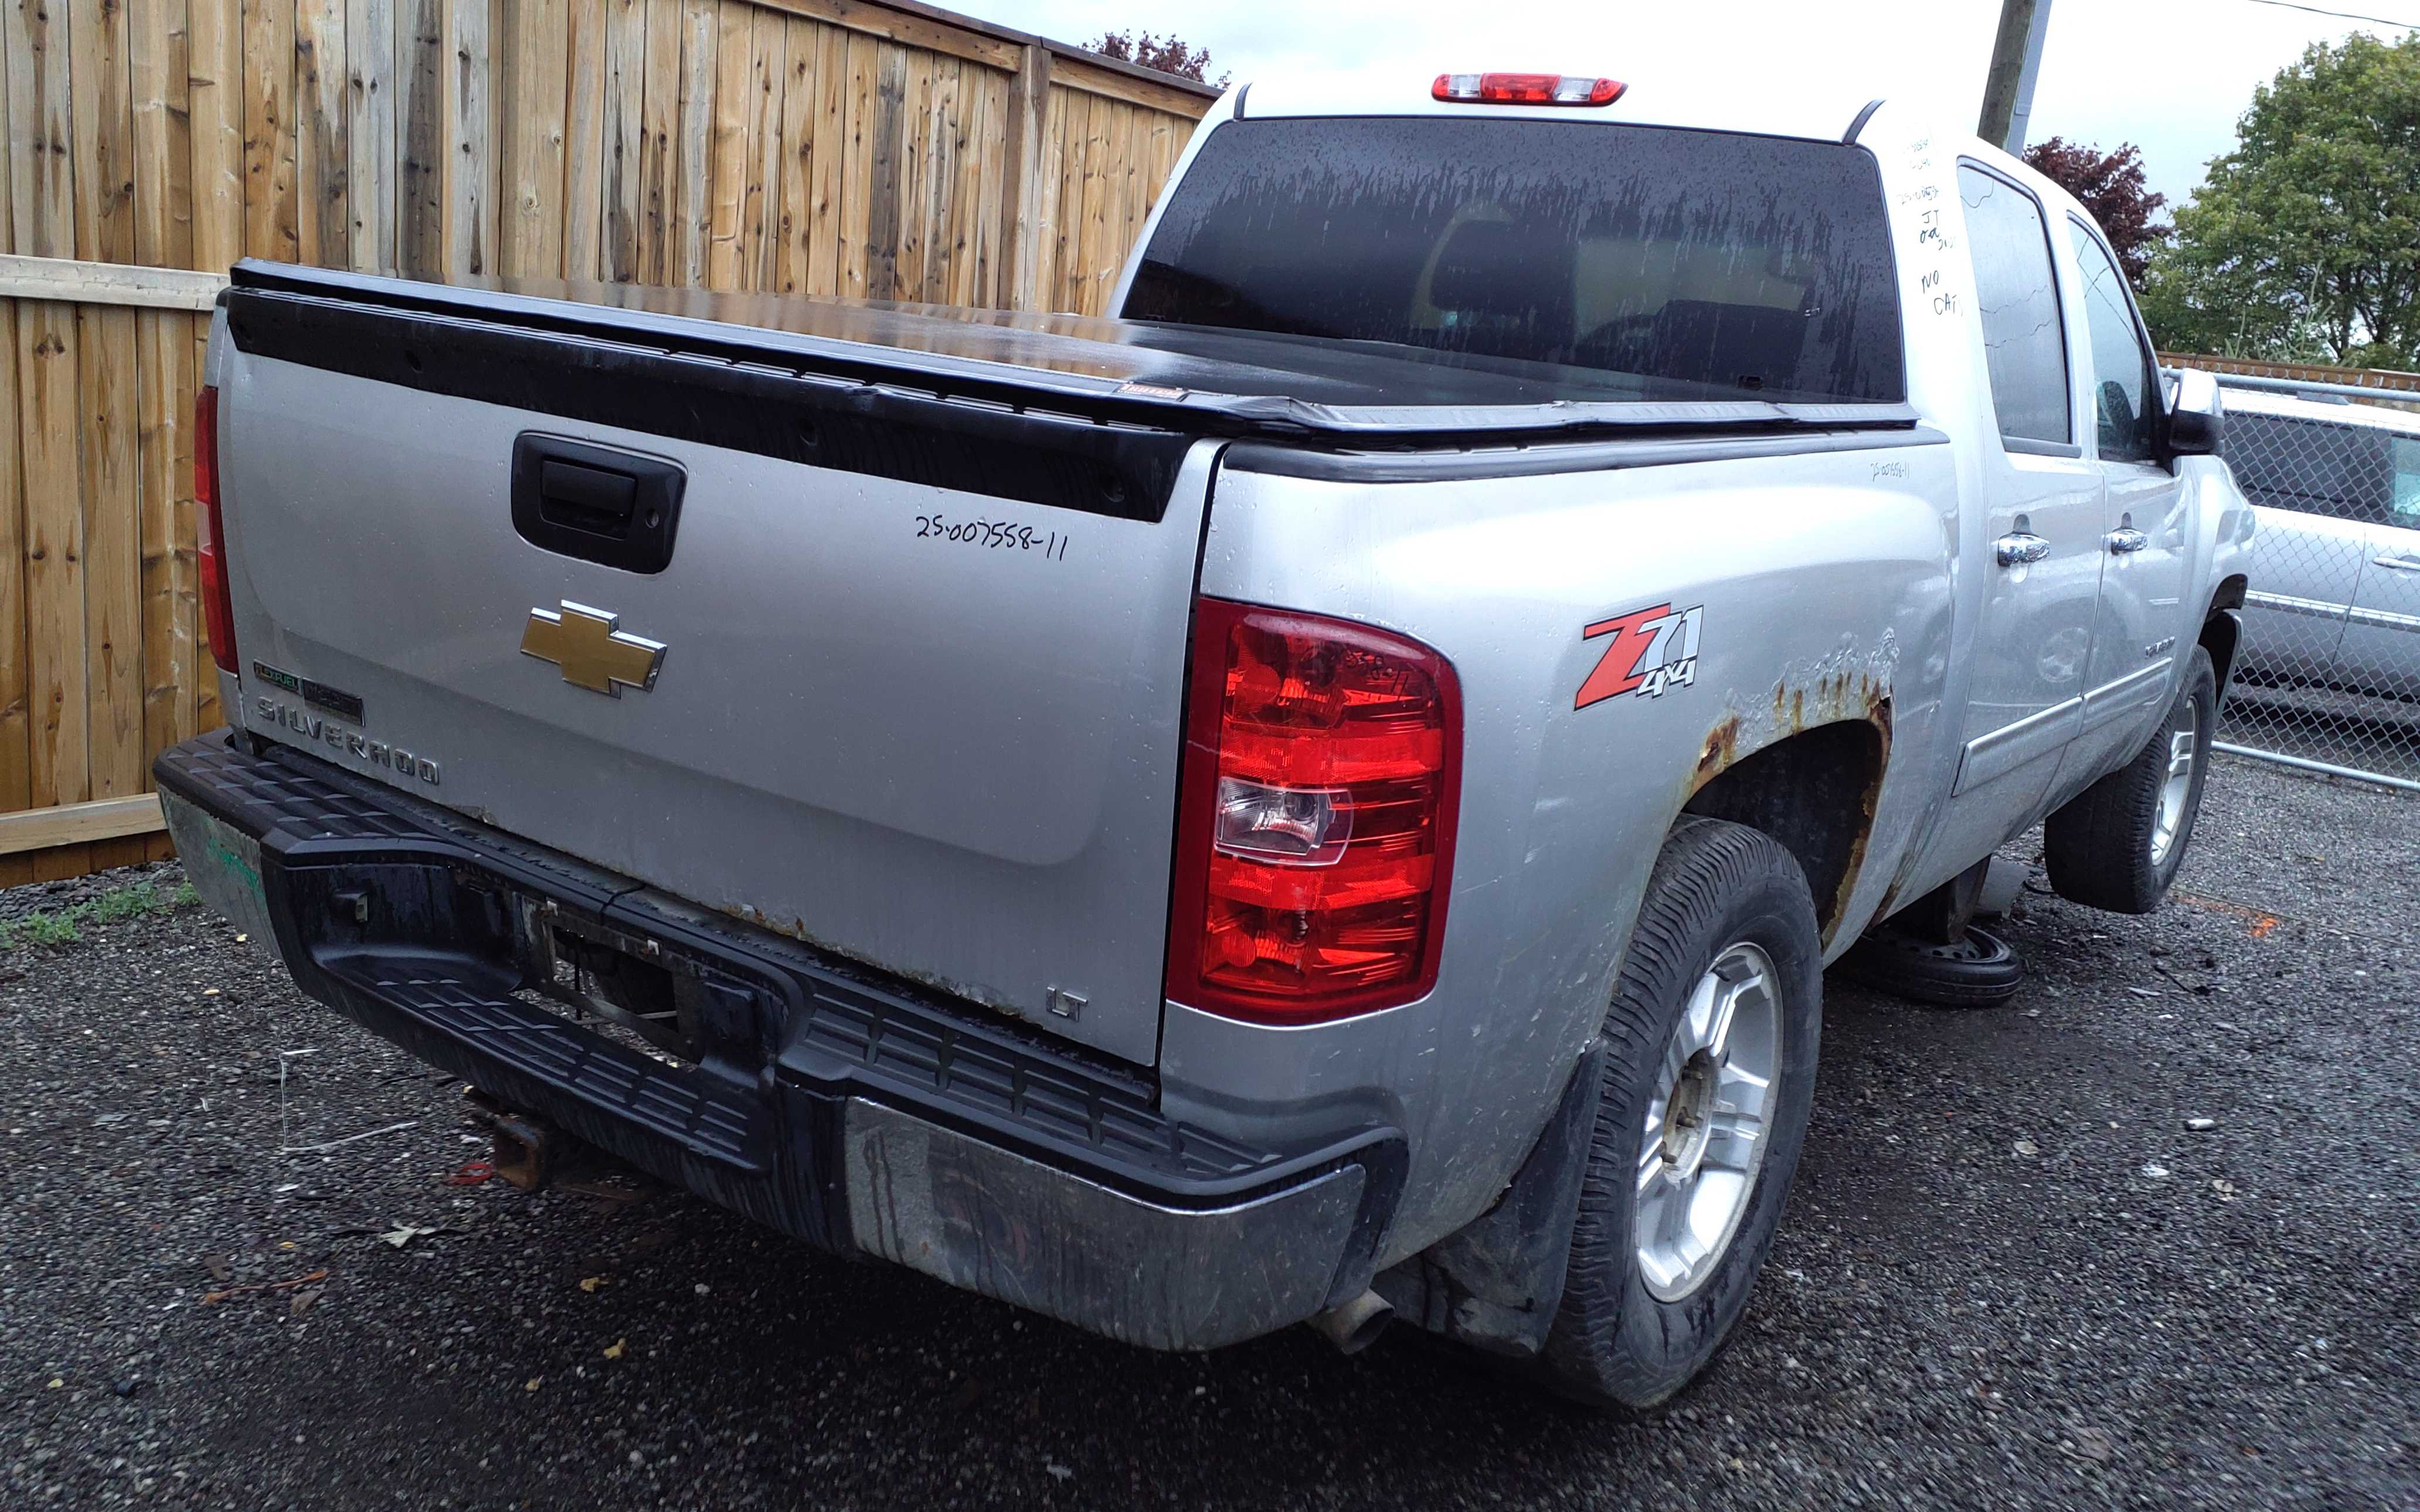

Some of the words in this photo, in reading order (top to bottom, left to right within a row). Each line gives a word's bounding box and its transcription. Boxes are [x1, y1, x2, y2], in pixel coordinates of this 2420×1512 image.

[1921, 270, 1939, 294] NO
[1573, 602, 1704, 711] Z71
[257, 696, 440, 786] SILVERADO
[1045, 985, 1089, 1022] LT
